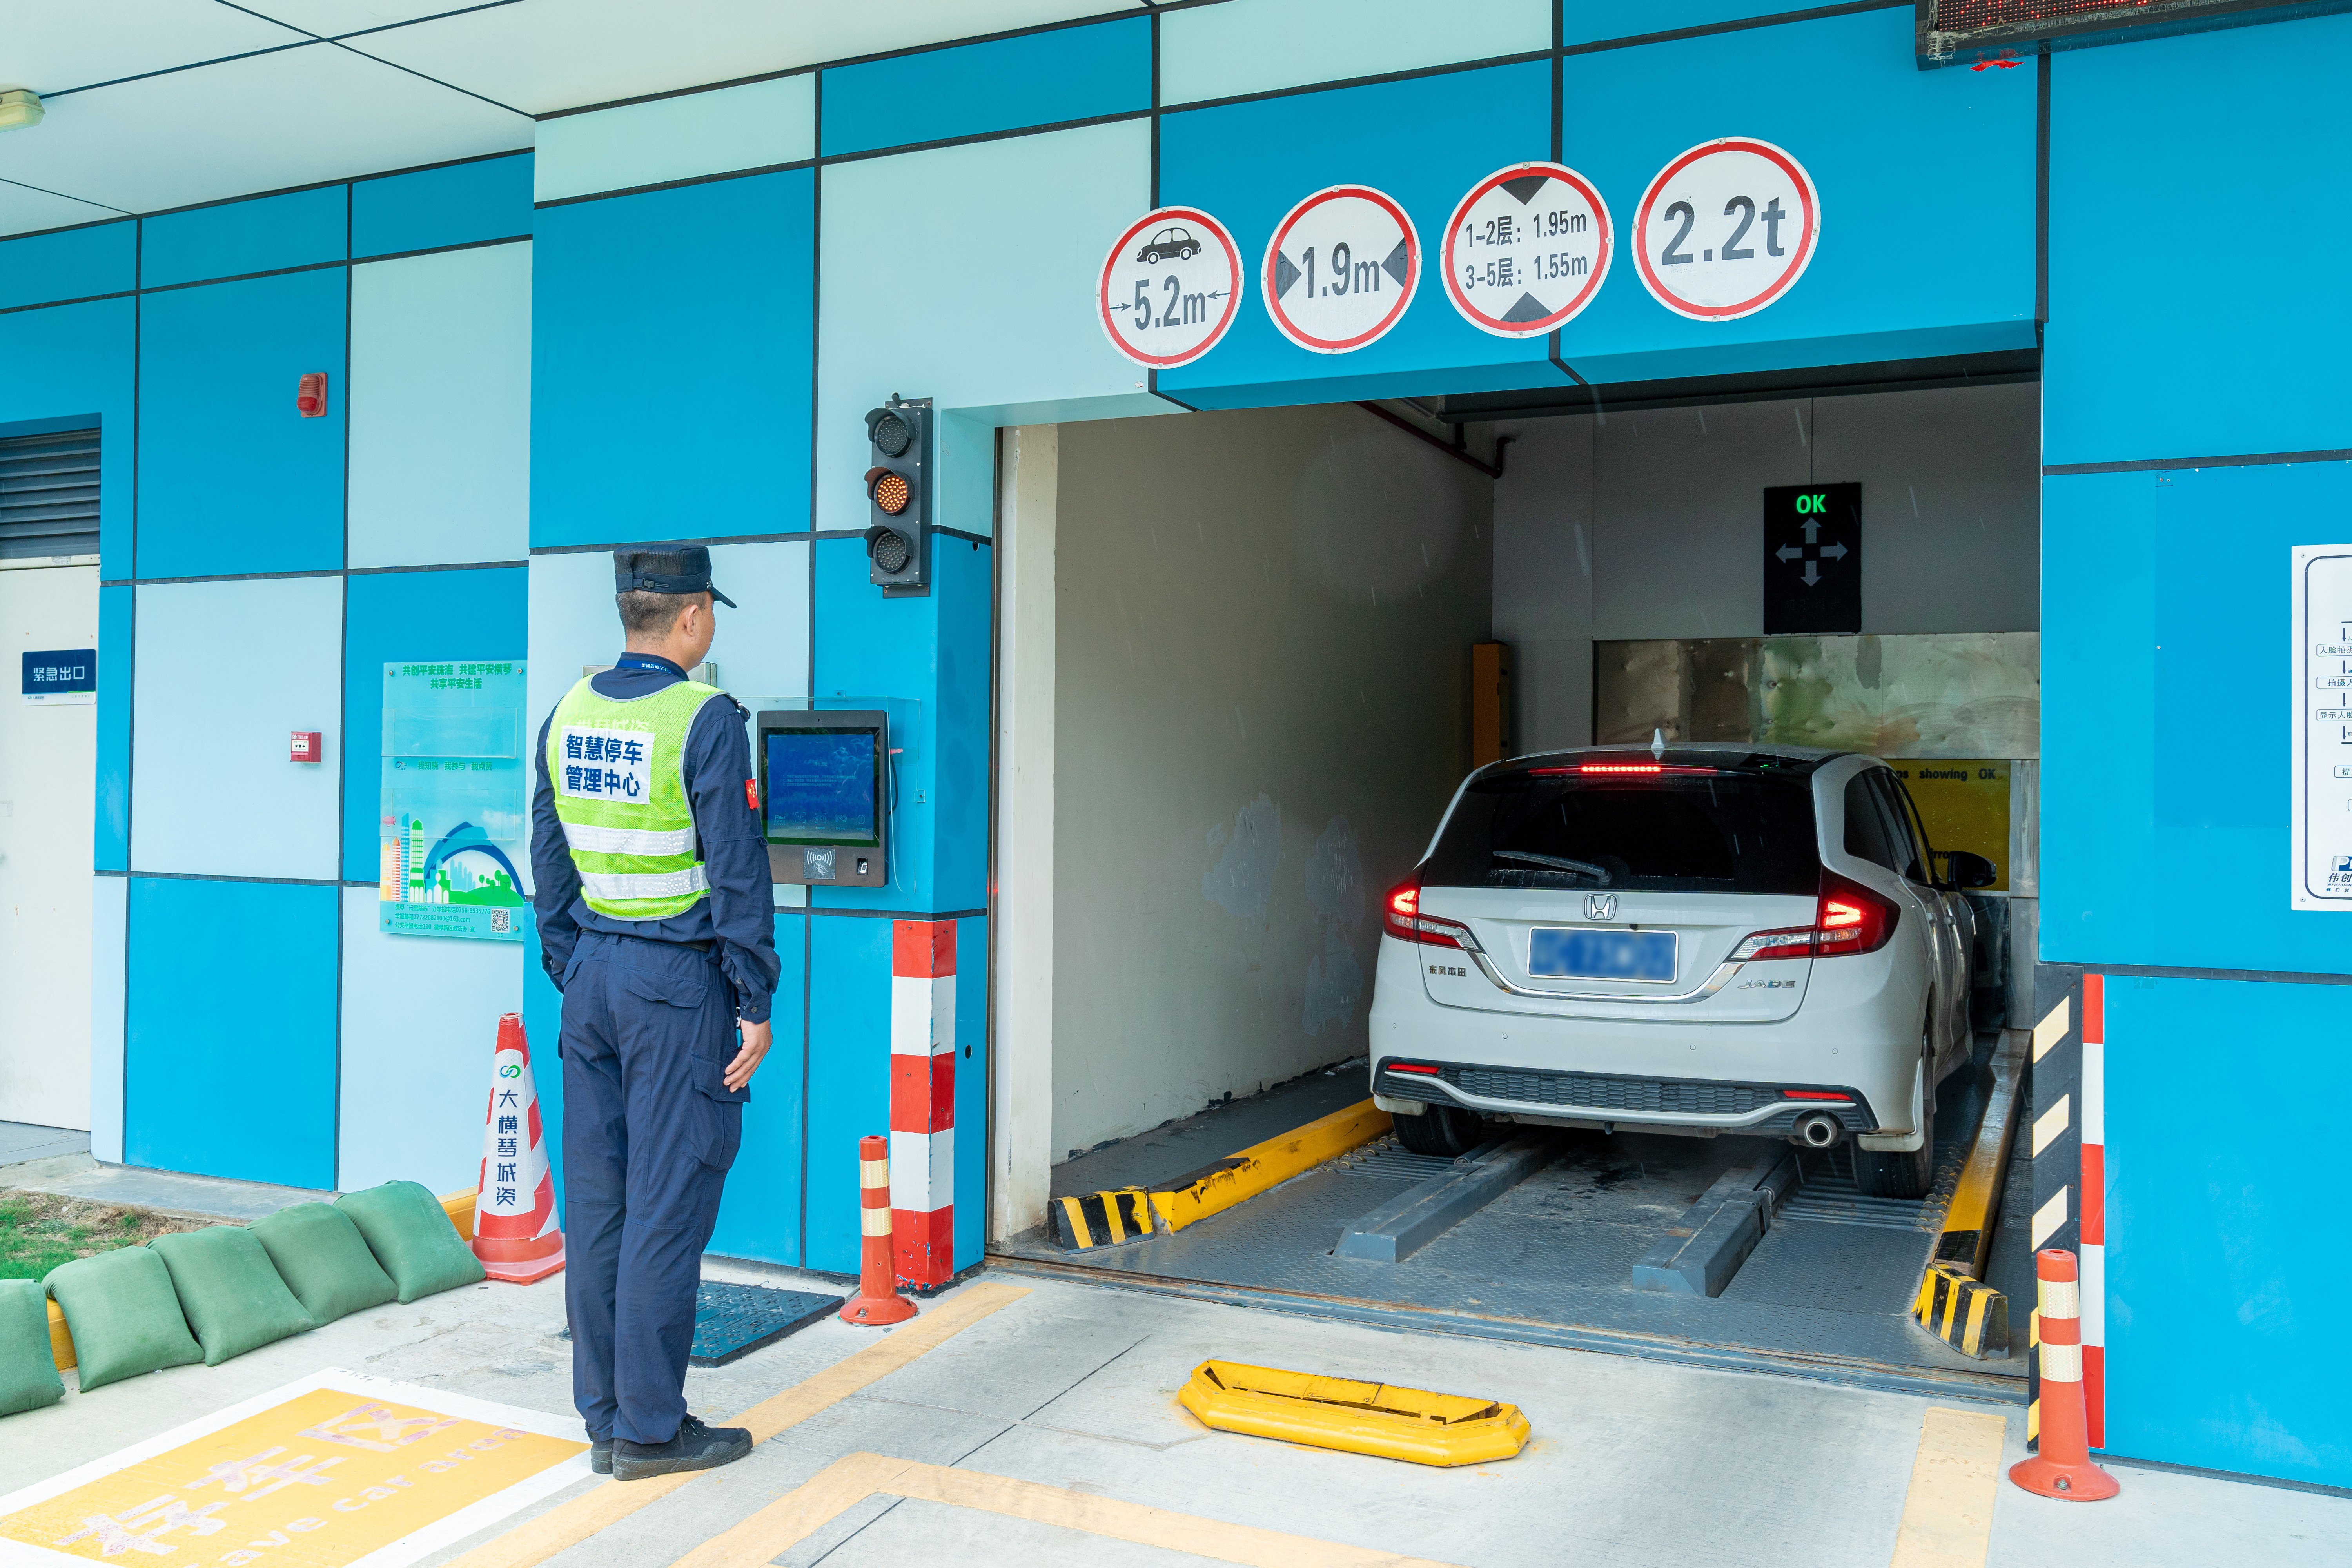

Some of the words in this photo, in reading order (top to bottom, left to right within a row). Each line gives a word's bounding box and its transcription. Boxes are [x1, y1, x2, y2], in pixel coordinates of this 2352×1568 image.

[1662, 195, 1786, 265] 2.2t
[1302, 242, 1380, 298] 1.9m
[1134, 275, 1207, 330] 5.2m
[1796, 494, 1826, 514] OK
[33, 666, 85, 681] 紧急出口
[402, 664, 454, 676] 共创平安珠海
[459, 663, 512, 675] 共建平安横琴
[430, 678, 482, 689] 共享平安生活
[566, 733, 643, 766] 智慧停车
[417, 761, 439, 770] 我知晓
[444, 761, 465, 771] 我参与
[471, 761, 492, 771] 我点赞
[1919, 768, 1967, 782] showing
[566, 765, 641, 797] 管理中心
[1930, 848, 1949, 859] irro
[1429, 965, 1466, 977] 东风本田
[1737, 979, 1796, 989] JADE
[496, 1089, 518, 1206] 大横琴城资
[53, 1402, 465, 1556] 存车区
[182, 1516, 328, 1568] ave
[332, 1475, 415, 1512] car
[418, 1427, 531, 1473] area
